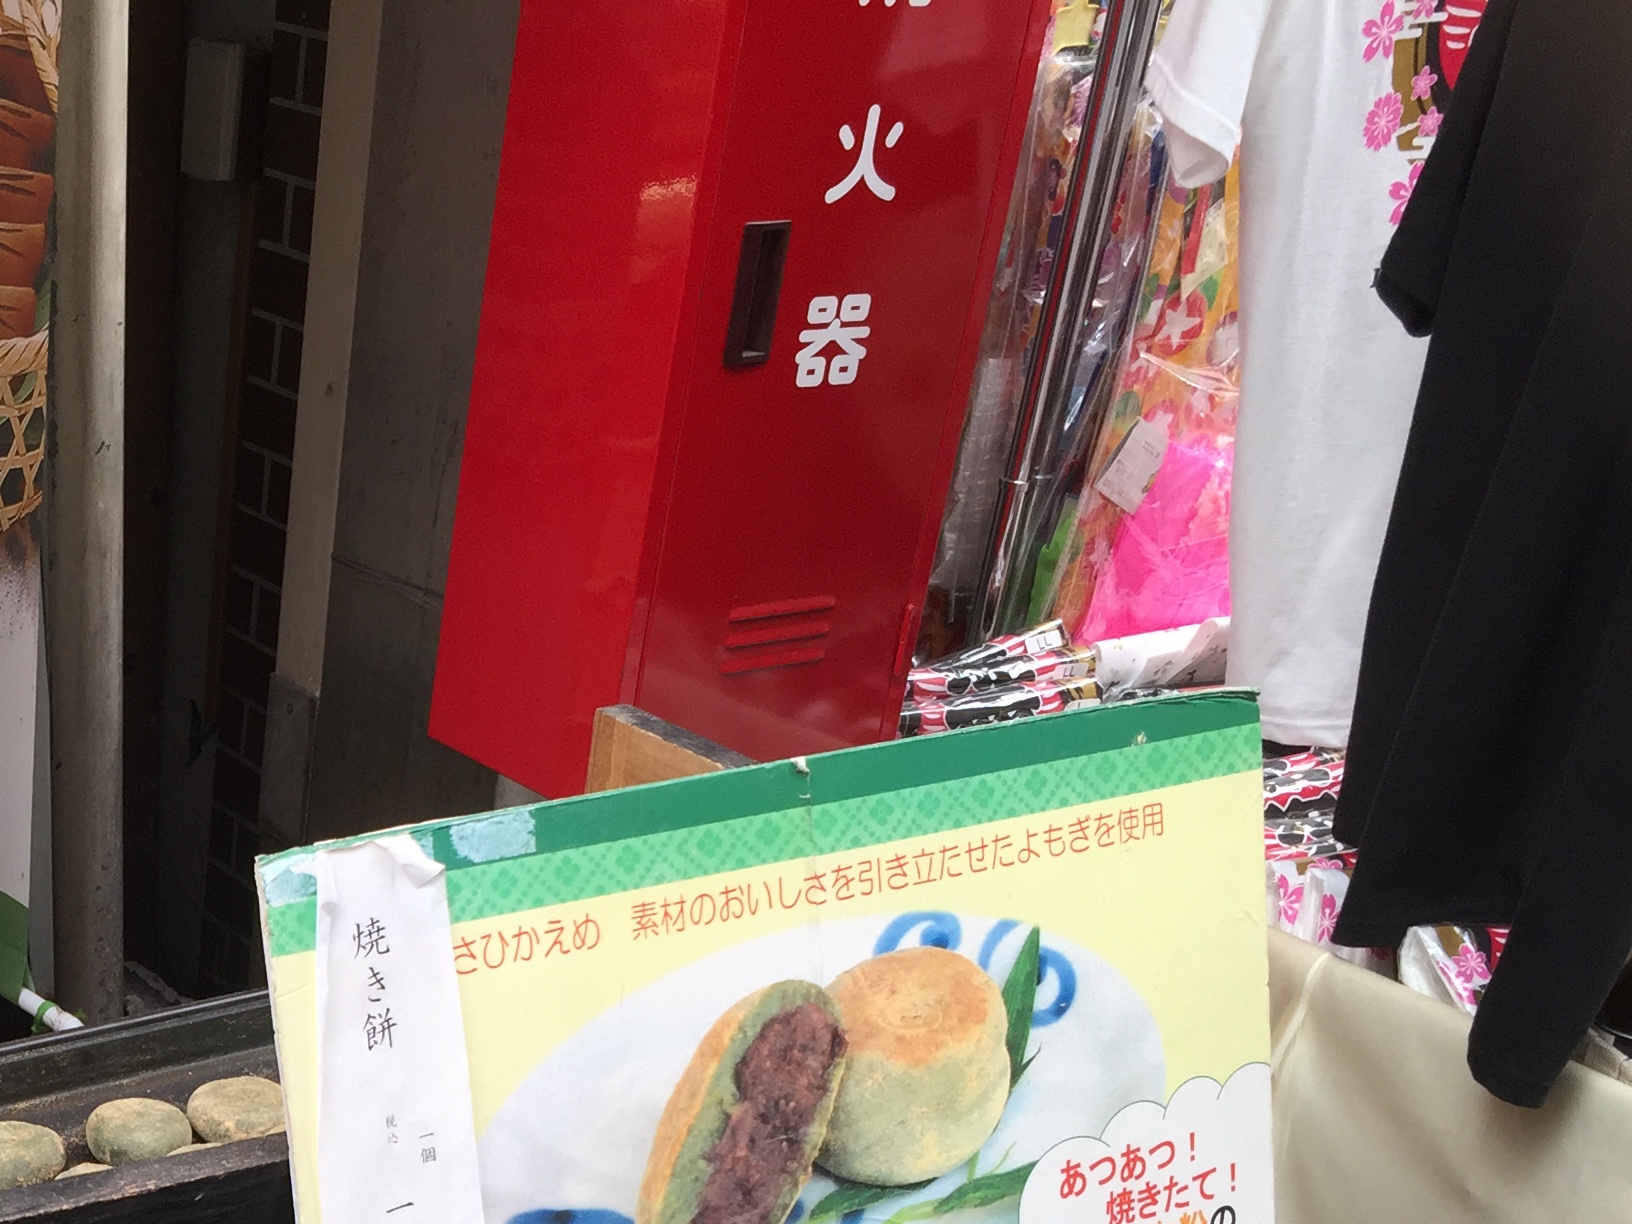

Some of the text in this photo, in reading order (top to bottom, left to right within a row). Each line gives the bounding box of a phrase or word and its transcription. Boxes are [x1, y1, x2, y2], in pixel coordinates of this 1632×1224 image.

[796, 0, 930, 388] 火器
[1036, 636, 1054, 650] LL
[1061, 665, 1076, 678] LL
[630, 801, 1165, 942] 素材のおいしさを引き立たせたよもぎを使用
[351, 917, 398, 1051] 焼き餅
[417, 1131, 438, 1164] 一個
